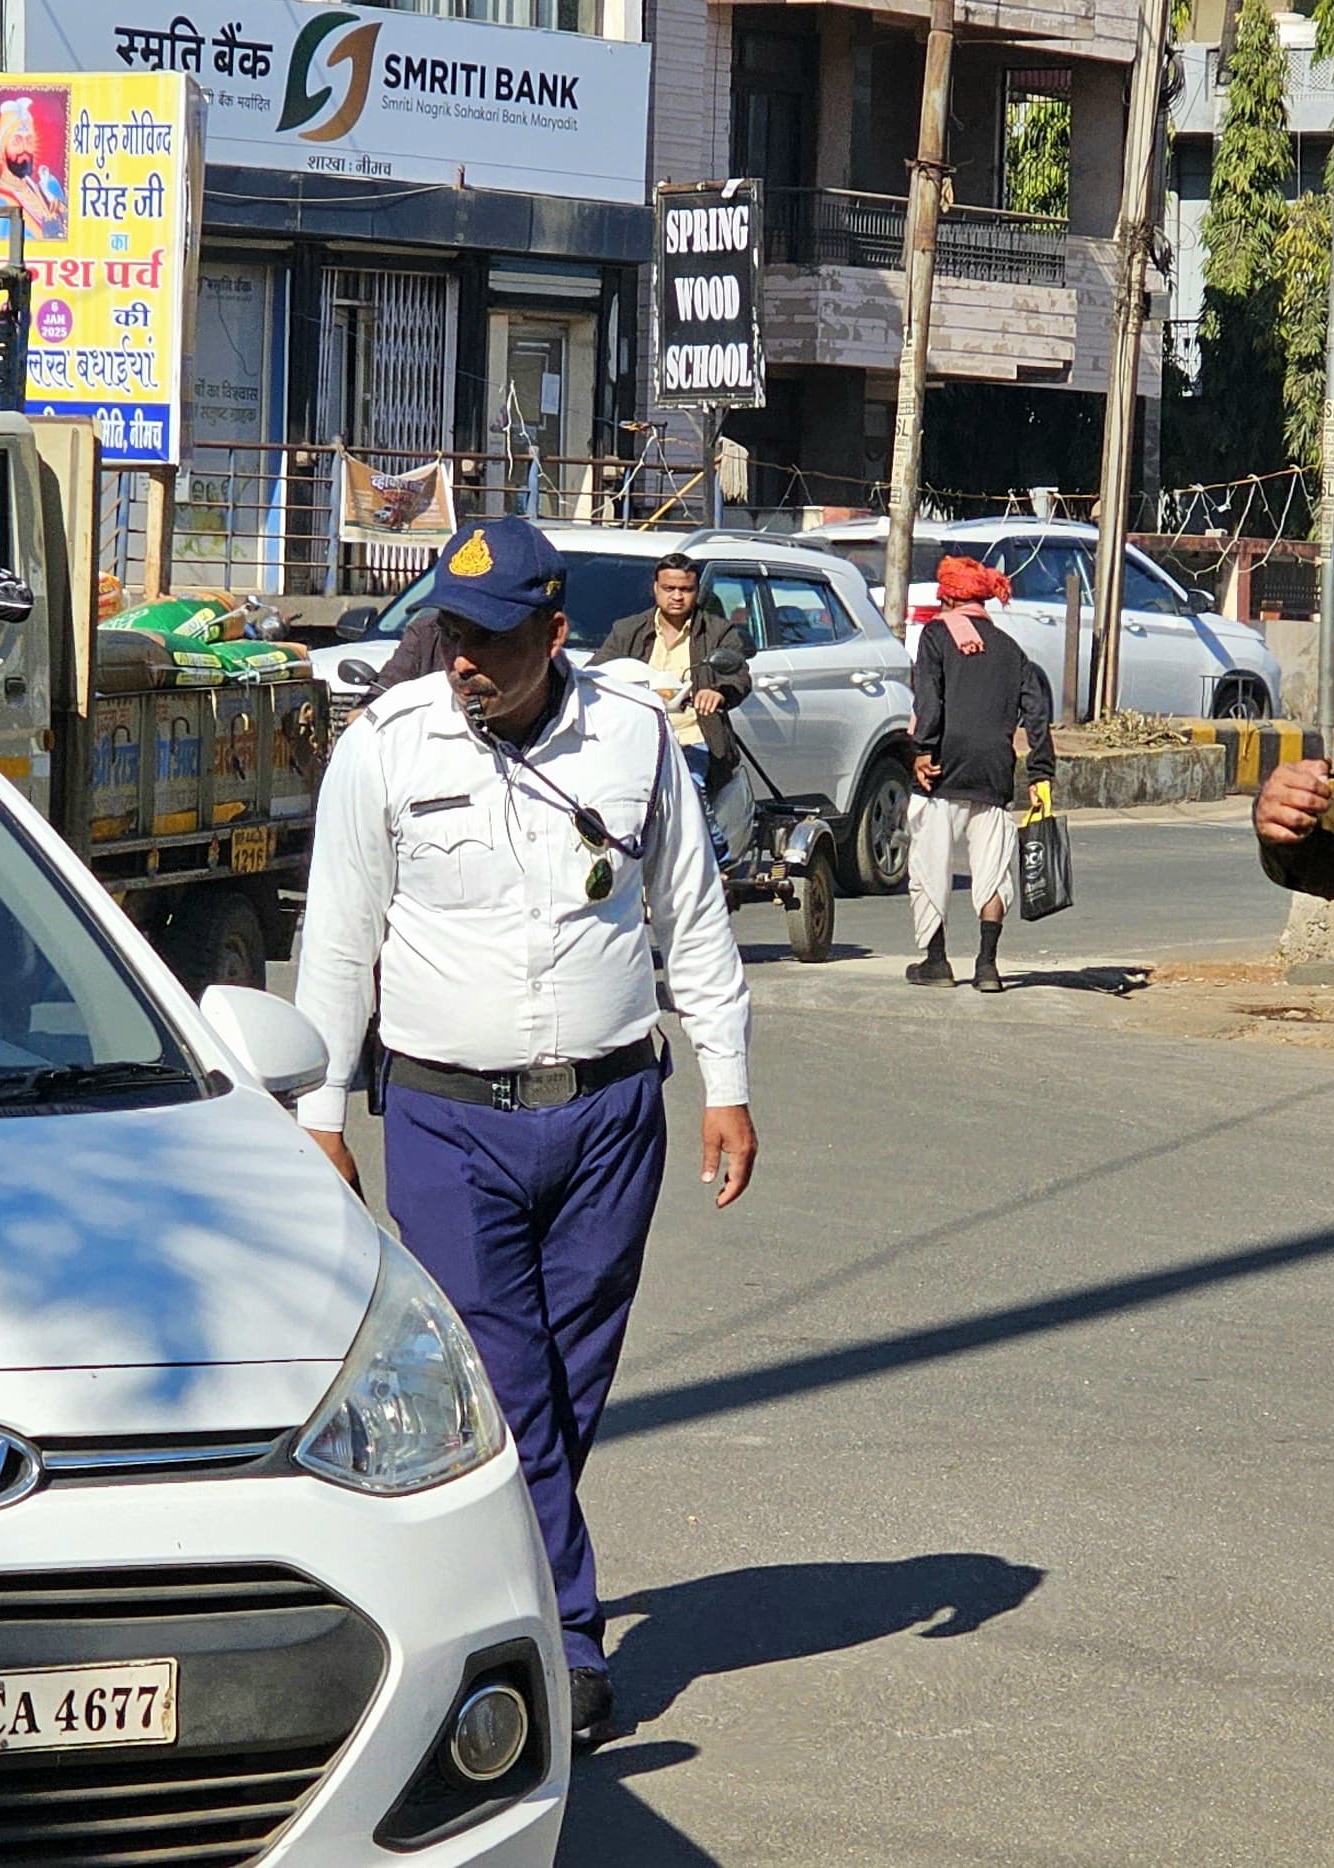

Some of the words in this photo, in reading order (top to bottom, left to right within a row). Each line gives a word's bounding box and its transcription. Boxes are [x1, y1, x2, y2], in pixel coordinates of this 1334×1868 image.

[212, 22, 274, 80] बैंक
[383, 53, 487, 99] SMRITI
[495, 66, 580, 110] BANK
[381, 95, 413, 112] Smriti
[416, 101, 452, 120] Nagrik
[454, 106, 500, 123] Sahakari
[502, 110, 528, 127] Bank
[530, 114, 578, 133] Maryadit
[73, 109, 90, 155] श्री
[94, 123, 119, 169] गुरु
[122, 109, 172, 156] गोविन्द
[307, 155, 346, 172] शाखा
[356, 154, 392, 176] नीमच
[81, 172, 128, 220] सिंह
[133, 172, 165, 218] जी
[110, 234, 129, 252] का
[665, 205, 750, 254] SPRING
[105, 249, 165, 289] पर्व
[113, 302, 152, 327] की
[674, 275, 740, 321] WOOD
[41, 326, 68, 337] 2025
[43, 315, 66, 325] JAN
[665, 342, 753, 390] SCHOOL
[130, 407, 163, 450] नीमच
[895, 419, 909, 437] SL
[54, 1686, 159, 1733] 4677
